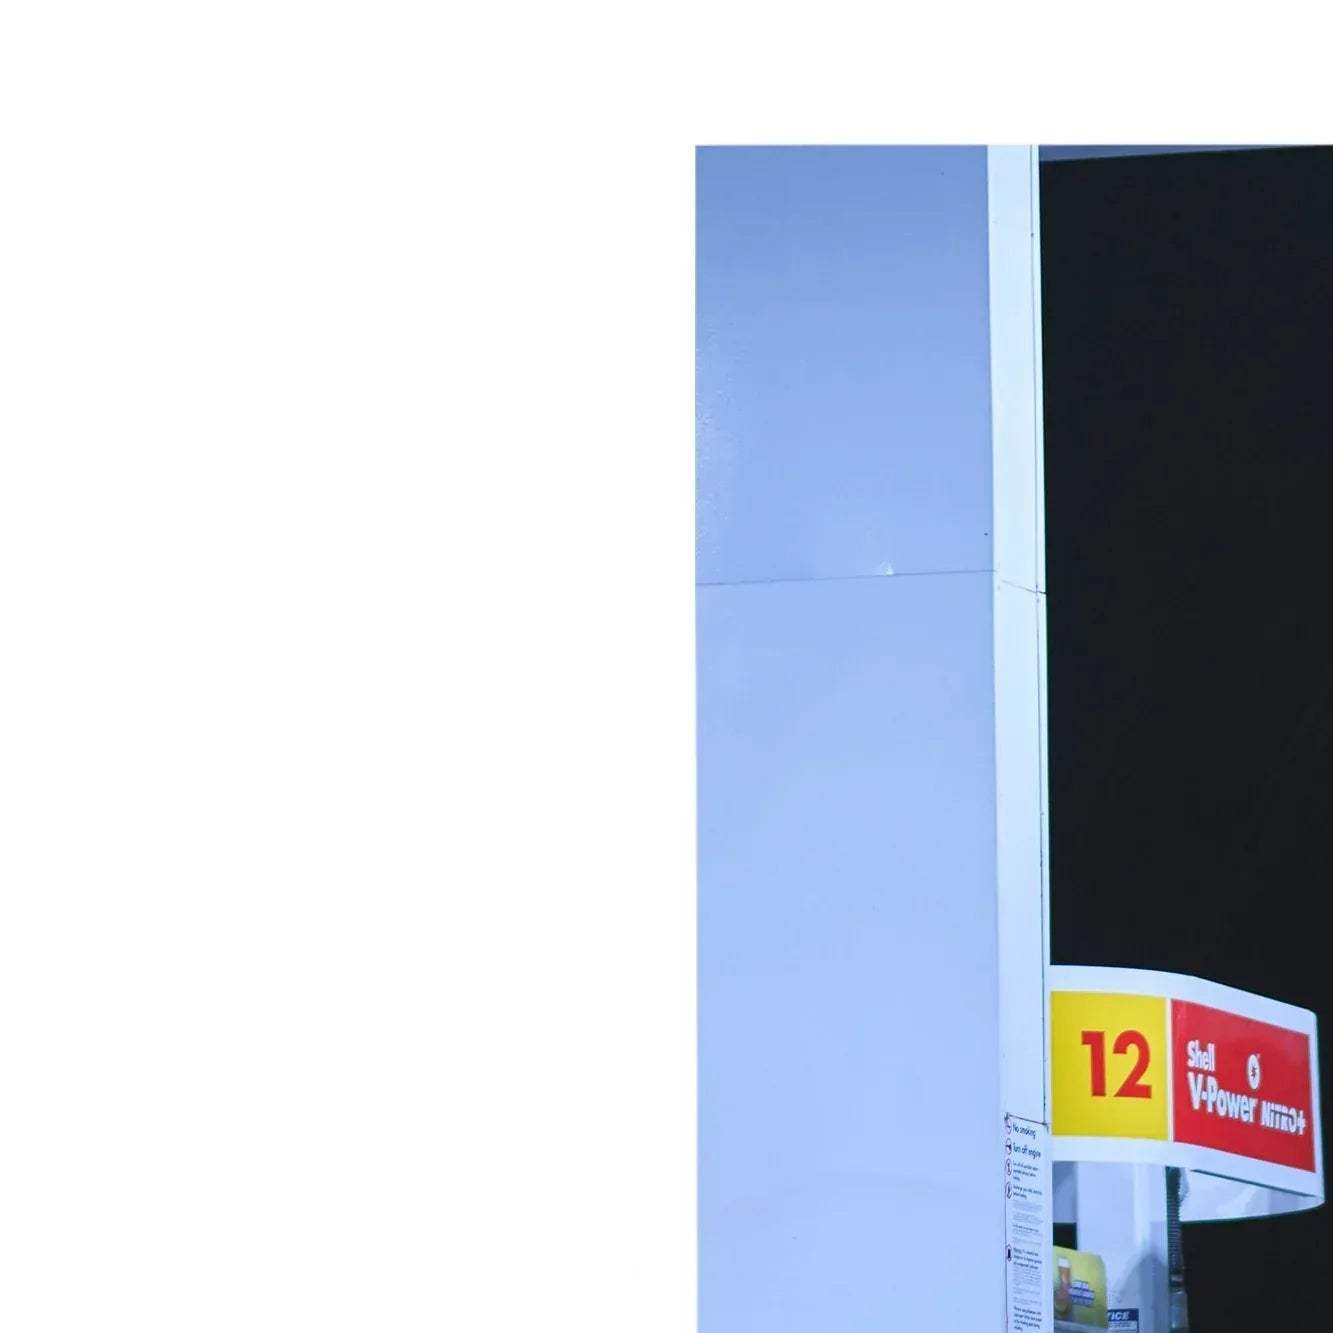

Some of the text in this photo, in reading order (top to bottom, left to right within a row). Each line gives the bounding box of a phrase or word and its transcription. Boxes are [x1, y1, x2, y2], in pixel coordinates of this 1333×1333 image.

[1081, 1030, 1152, 1099] 12
[1187, 1040, 1216, 1071] Shell
[1187, 1071, 1258, 1123] V-Power
